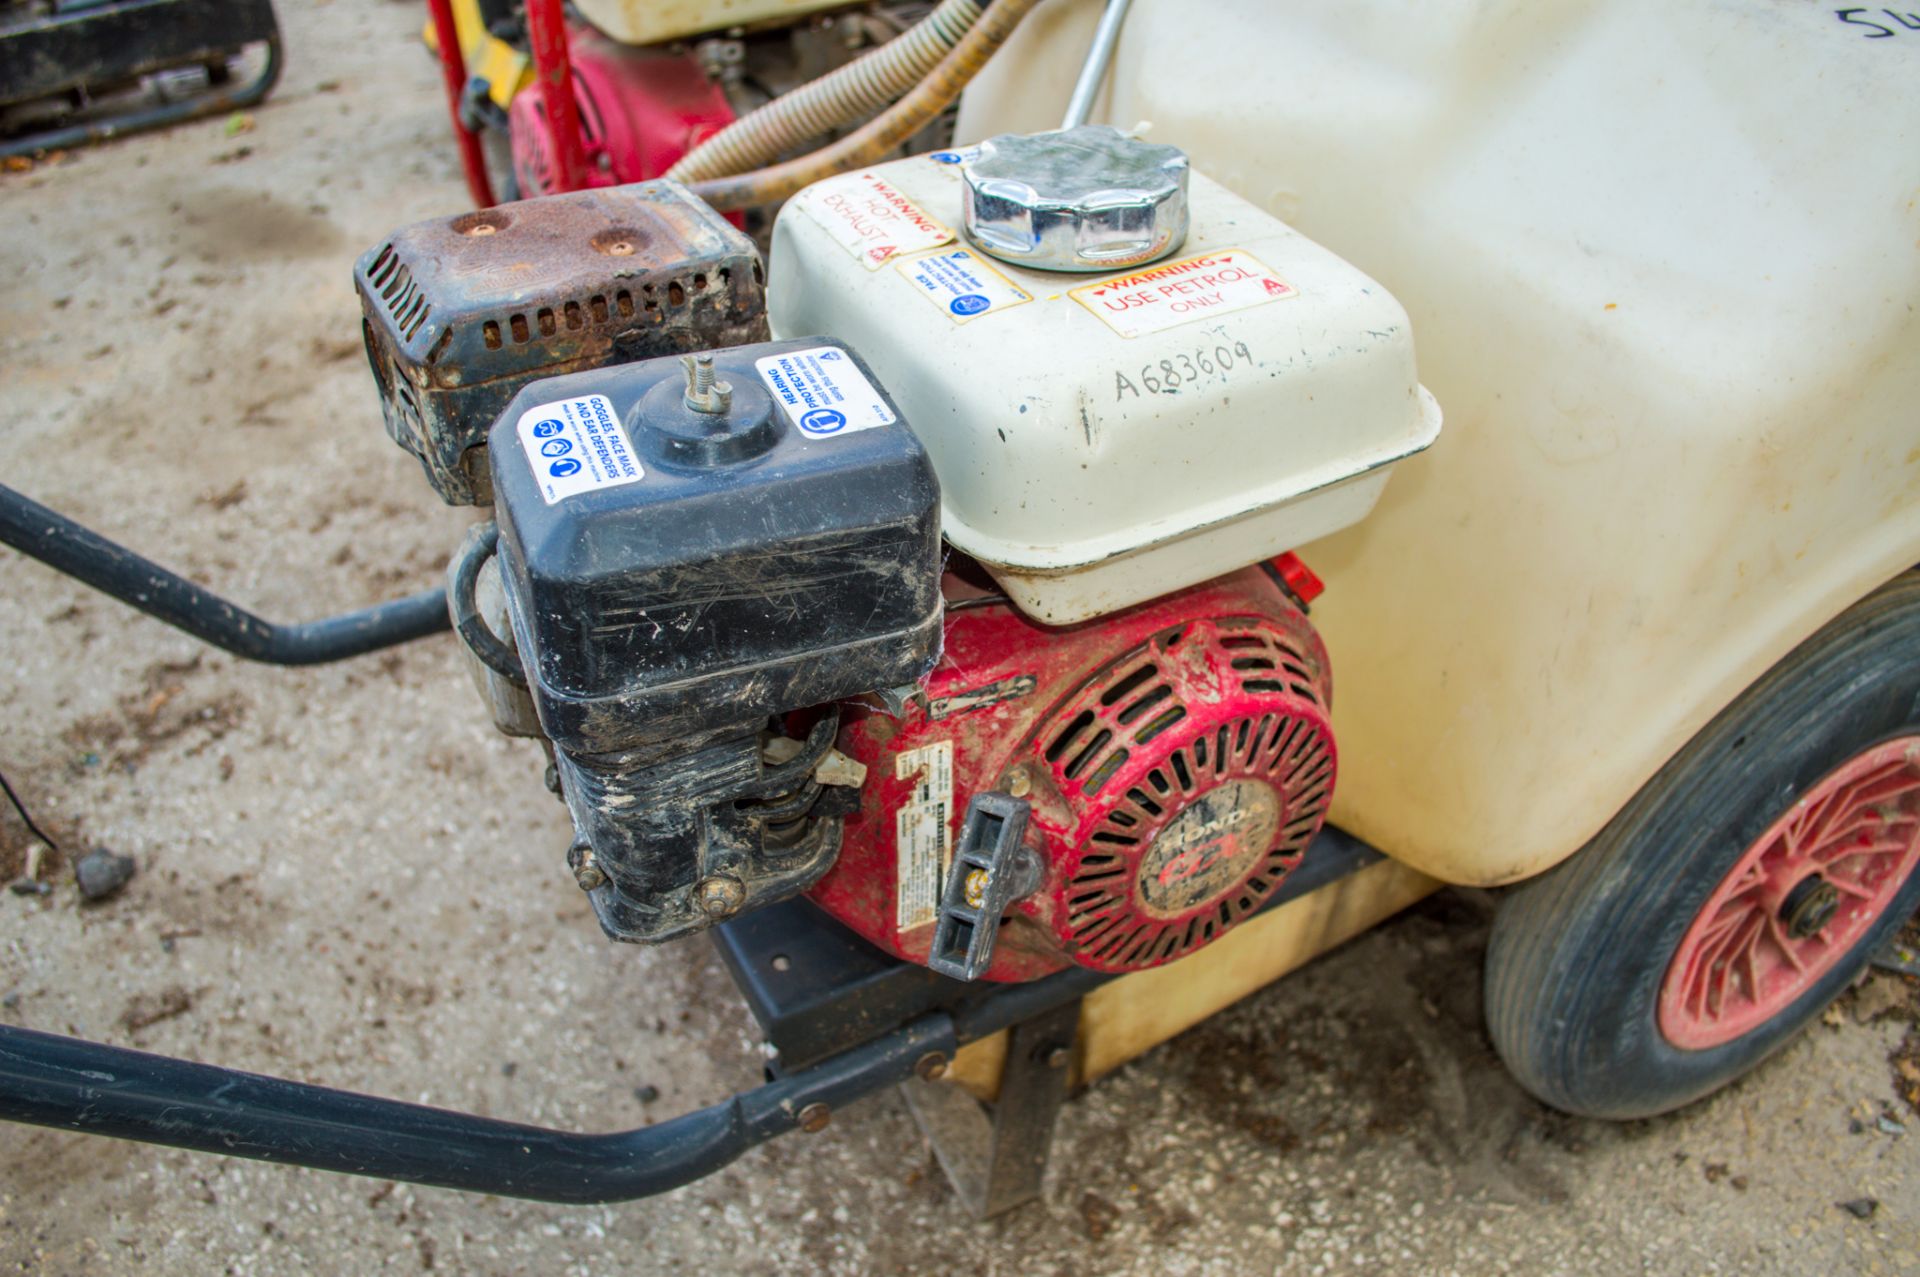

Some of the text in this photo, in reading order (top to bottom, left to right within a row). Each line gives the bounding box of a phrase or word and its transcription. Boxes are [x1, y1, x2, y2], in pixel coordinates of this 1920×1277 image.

[823, 194, 889, 241] EXHAUST
[866, 200, 901, 221] HOT
[872, 182, 937, 232] WARNING
[915, 274, 938, 291] FACE
[918, 260, 963, 295] PROTECTION
[1103, 267, 1259, 312] USE PETROL
[1104, 256, 1217, 291] WARNING
[1261, 278, 1284, 293] A
[1170, 291, 1225, 313] ONLY
[768, 369, 799, 405] HEARING
[778, 358, 819, 409] PROTECTION
[1115, 340, 1253, 402] A683609
[575, 402, 620, 479] AND EAR DEFENDERS
[590, 397, 638, 477] GOGGLES, FACE MASK
